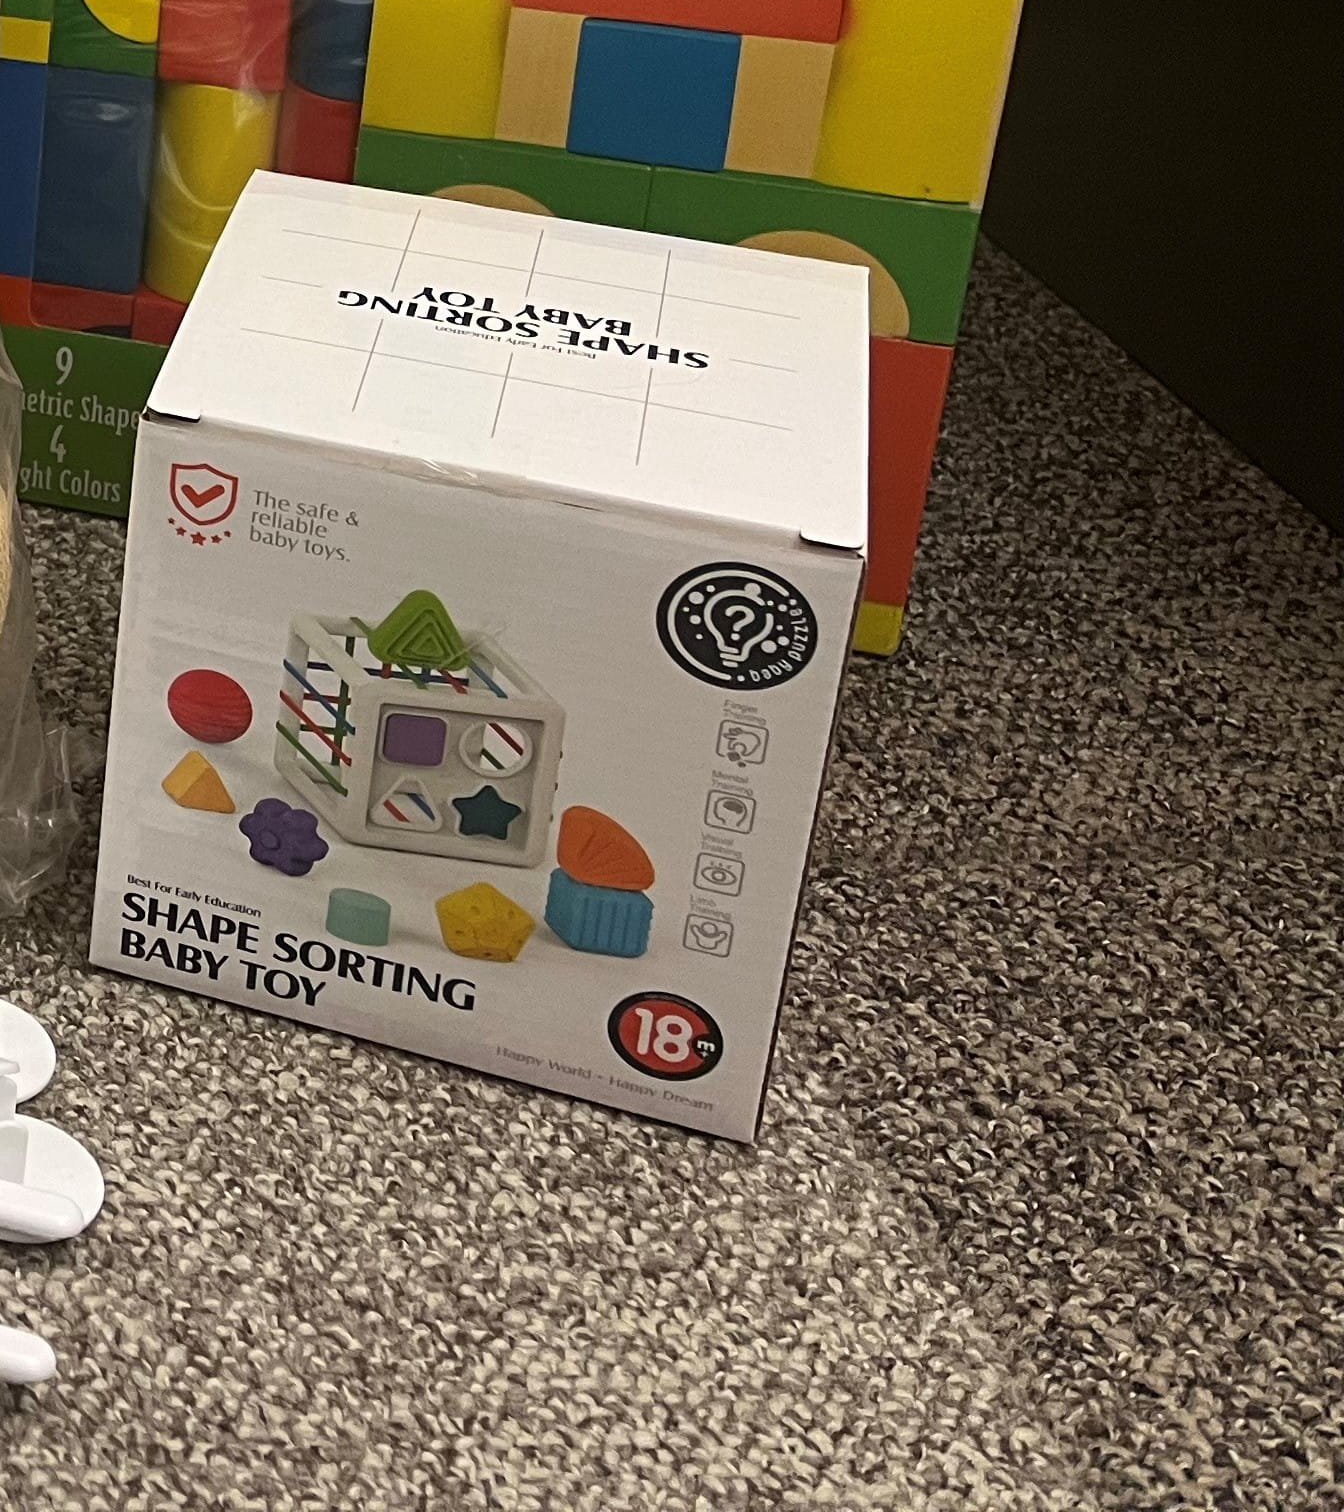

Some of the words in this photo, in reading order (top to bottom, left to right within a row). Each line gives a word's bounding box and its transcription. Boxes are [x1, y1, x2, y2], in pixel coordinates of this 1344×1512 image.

[337, 290, 540, 339] SORTING
[412, 286, 500, 314] TOY
[515, 295, 632, 337] BABY
[55, 346, 74, 385] 9
[557, 328, 710, 369] SHAPE
[49, 424, 67, 463] 4
[59, 469, 121, 503] Colors
[251, 511, 328, 538] reliable
[253, 489, 290, 513] The
[296, 502, 339, 523] safe
[345, 511, 360, 527] &
[249, 525, 300, 553] baby
[304, 539, 351, 563] toys.
[748, 658, 794, 682] baby
[787, 607, 809, 662] puzzle
[127, 874, 152, 890] Best
[154, 880, 173, 895] For
[175, 887, 202, 904] Early
[204, 895, 262, 918] Education
[120, 927, 229, 981] BABY
[240, 959, 327, 1007] TOY
[122, 891, 260, 954] SHAPE
[272, 932, 477, 1011] SORTING
[634, 1007, 693, 1063] 18
[496, 1045, 544, 1070] Happy
[548, 1057, 592, 1080] World
